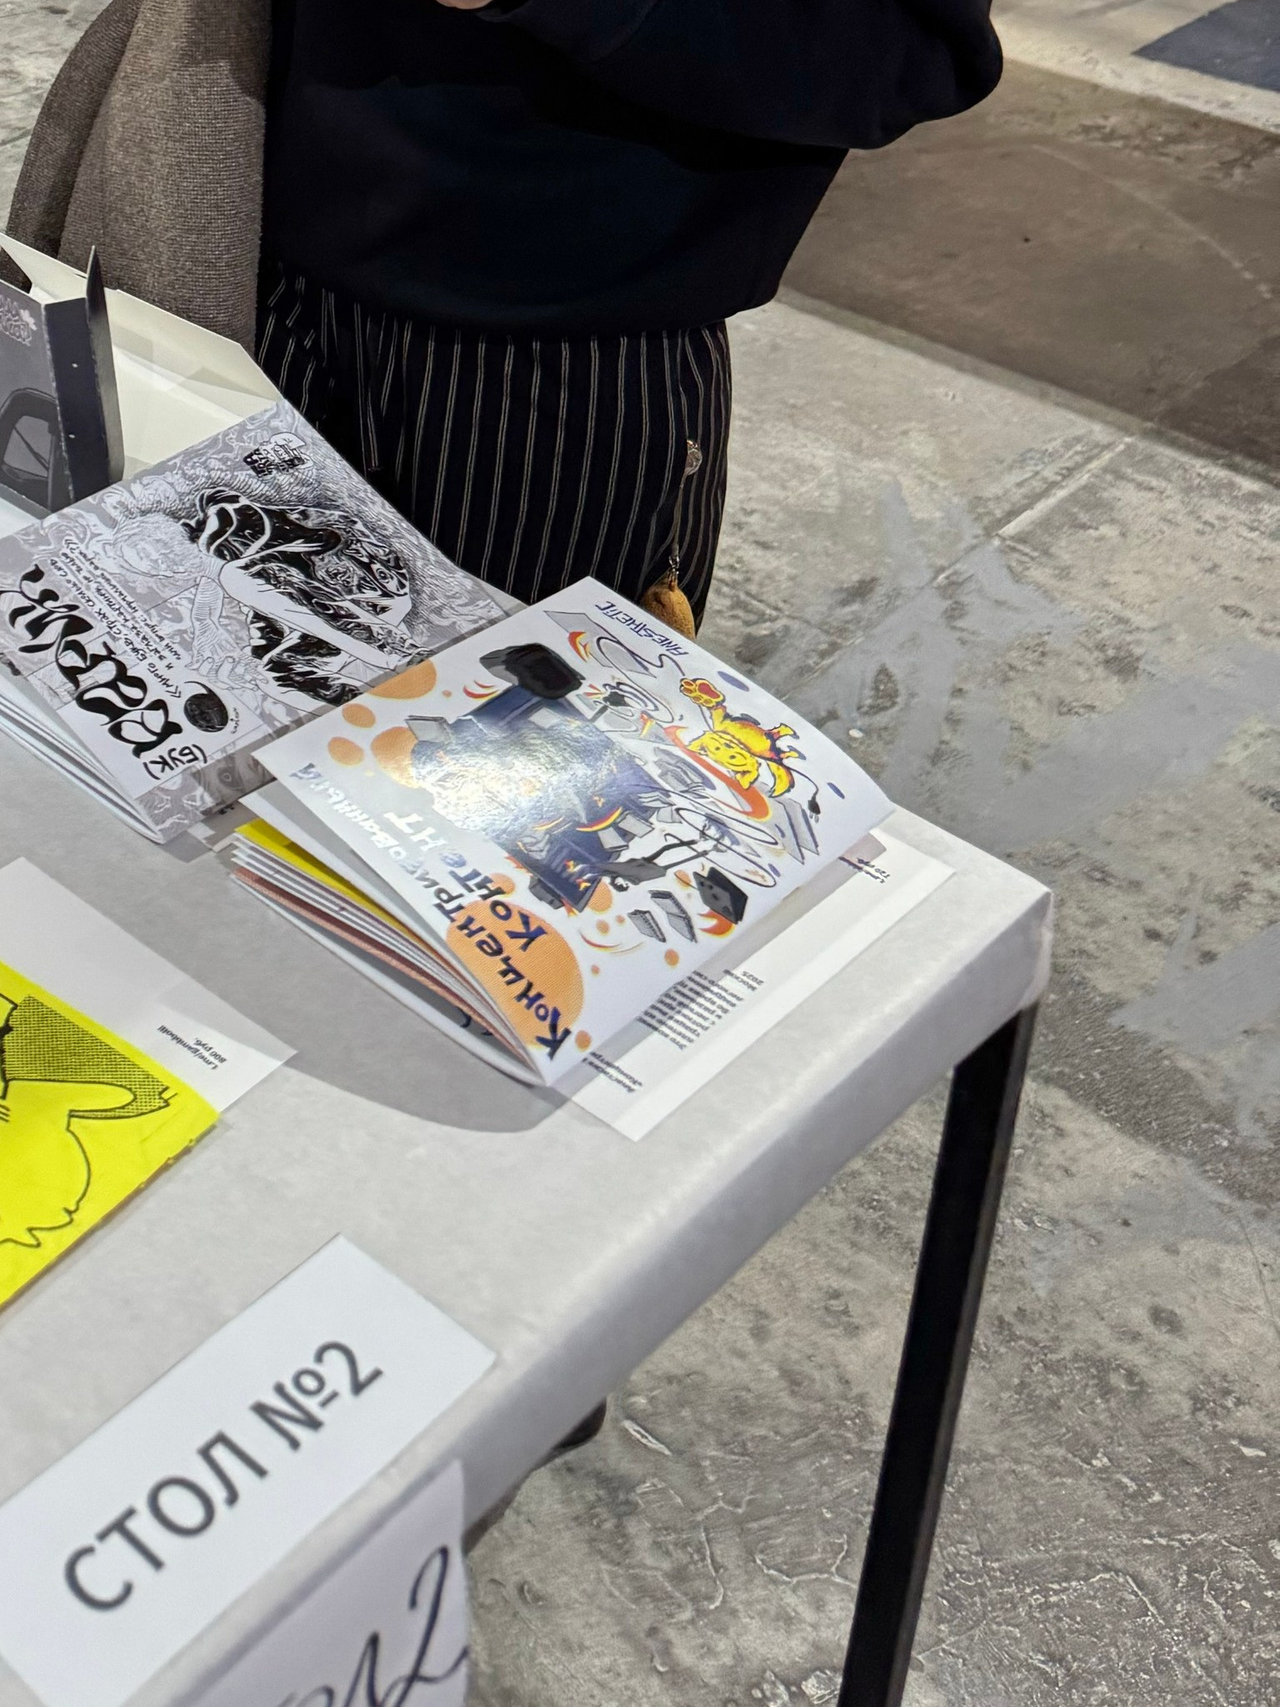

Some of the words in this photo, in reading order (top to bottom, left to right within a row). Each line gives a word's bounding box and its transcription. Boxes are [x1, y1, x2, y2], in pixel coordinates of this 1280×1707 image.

[594, 600, 689, 656] ANESTHETIC
[63, 1430, 269, 1613] СТОЛ
[249, 1340, 384, 1452] №2
